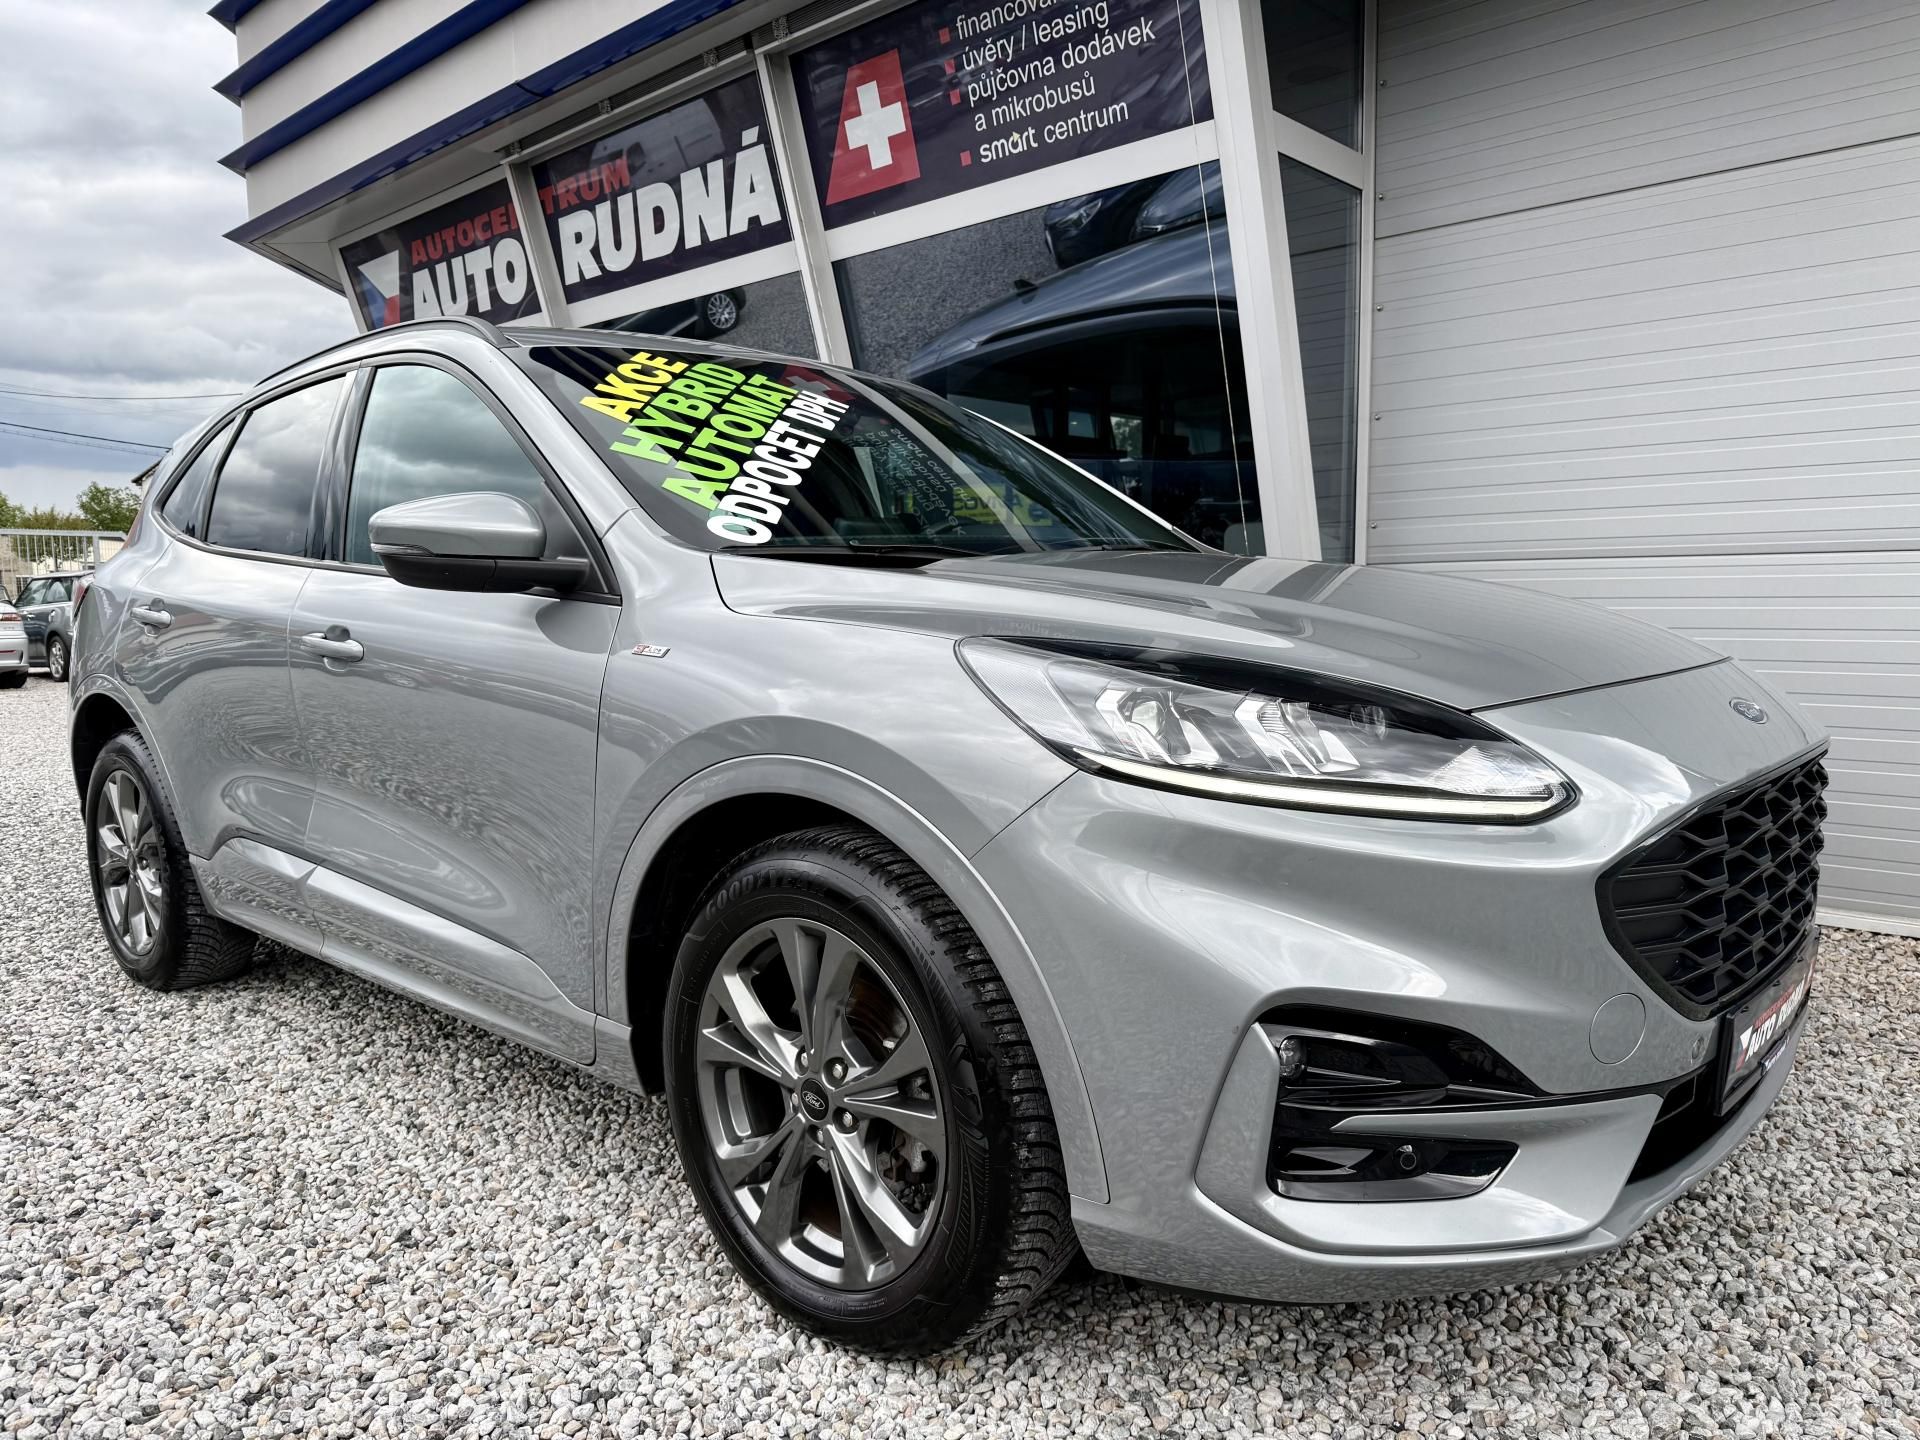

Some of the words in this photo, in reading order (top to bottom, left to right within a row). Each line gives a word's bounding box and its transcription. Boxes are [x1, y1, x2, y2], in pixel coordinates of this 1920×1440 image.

[962, 36, 1014, 70] úvěry
[1032, 1, 1109, 46] leasing
[967, 56, 1056, 107] půjčovna
[1061, 16, 1156, 69] dodávek
[974, 112, 988, 132] a
[991, 70, 1096, 126] mikrobusů
[979, 126, 1039, 163] smart
[1043, 101, 1130, 144] centrum
[412, 238, 528, 322] AUTO
[558, 126, 782, 286] RUDNÁ
[579, 352, 688, 423] AKCE
[609, 362, 746, 465] HYBRID
[661, 374, 799, 511] AUTOMAT
[706, 422, 826, 544] ODPOCET
[782, 390, 850, 431] DPH
